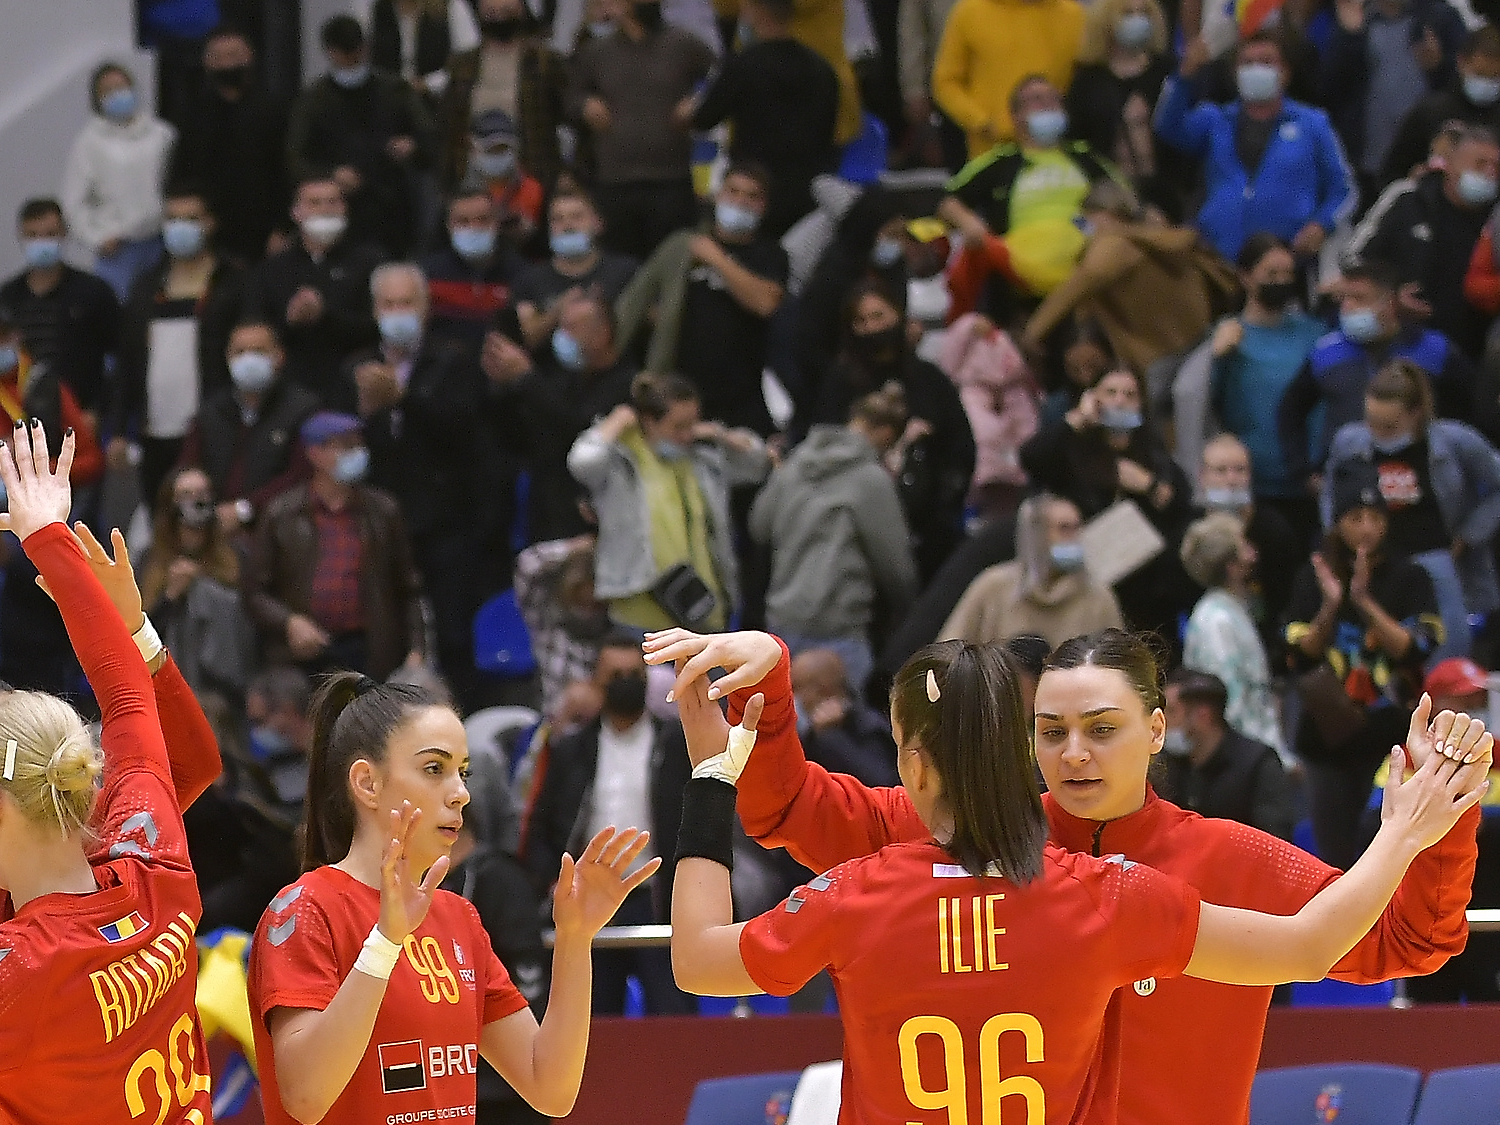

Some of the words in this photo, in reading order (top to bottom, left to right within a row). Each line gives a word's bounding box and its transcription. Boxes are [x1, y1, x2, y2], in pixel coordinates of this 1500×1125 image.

[402, 933, 461, 1004] 99
[938, 893, 1009, 974] ILIE
[386, 1108, 436, 1125] GROUPE
